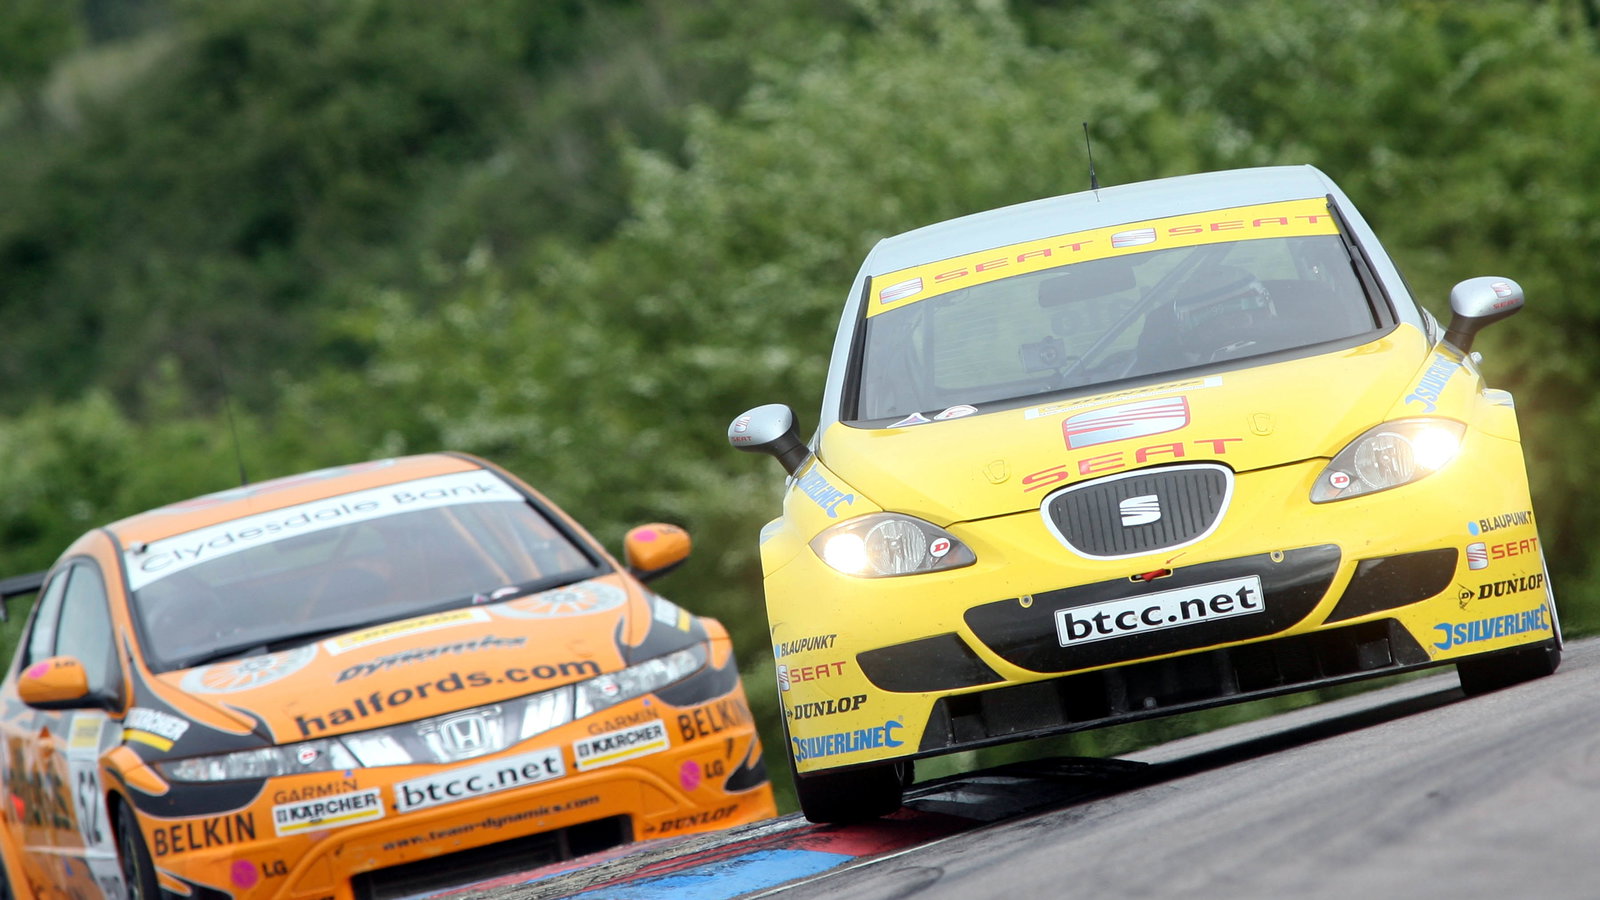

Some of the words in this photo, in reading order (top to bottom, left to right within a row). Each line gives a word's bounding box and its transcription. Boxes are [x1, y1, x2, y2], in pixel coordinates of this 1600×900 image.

[1168, 215, 1328, 237] SEAT
[935, 240, 1093, 284] SEAT
[1022, 438, 1242, 493] SEAT
[140, 498, 379, 573] Clydesdale
[393, 481, 499, 504] Bank
[1479, 511, 1532, 533] BLAUPUNKT
[1491, 538, 1537, 559] SEAT
[1478, 573, 1543, 600] DUNLOP
[1064, 585, 1257, 641] btcc.net
[781, 634, 837, 657] BLAUPUNKT
[790, 661, 846, 683] SEAT
[294, 659, 602, 738] halfords.com
[794, 694, 867, 720] DUNLOP
[588, 707, 658, 735] GARMIN
[402, 754, 561, 808] btcc.net
[704, 759, 723, 778] LG
[274, 779, 357, 805] GARMIN
[382, 795, 599, 851] www.team-dynamics.com
[659, 804, 738, 833] DUNLOP
[153, 812, 256, 857] BELKIN
[262, 860, 288, 878] LG
